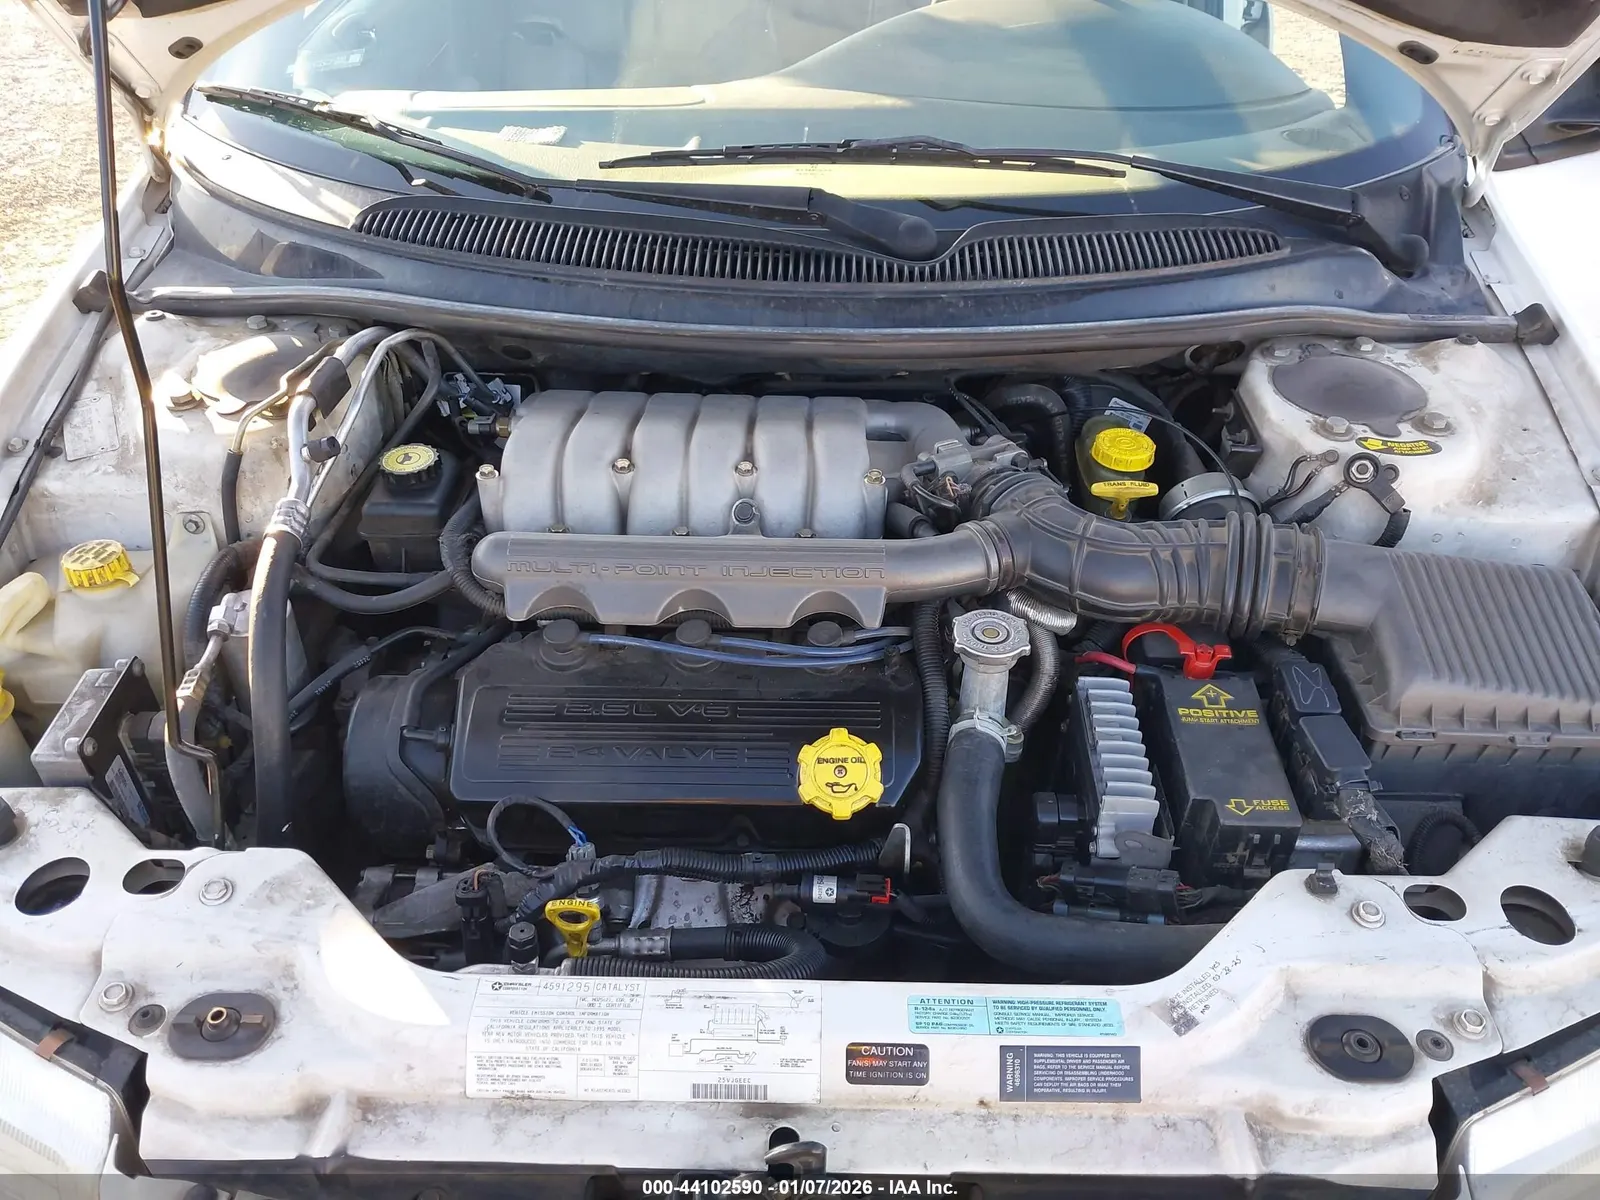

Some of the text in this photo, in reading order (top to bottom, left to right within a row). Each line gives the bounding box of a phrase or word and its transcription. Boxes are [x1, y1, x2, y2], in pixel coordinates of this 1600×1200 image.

[722, 565, 885, 578] INJECTION
[1178, 708, 1258, 718] POSITIVE
[612, 746, 738, 760] VALVE
[1182, 972, 1211, 998] INSTALLED
[1209, 960, 1220, 972] yes
[543, 982, 640, 992] 4591295 CATALYST
[1182, 982, 1212, 1006] INSTALLED
[1188, 987, 1219, 1012] RETRUNED
[861, 1046, 914, 1056] CAUTION
